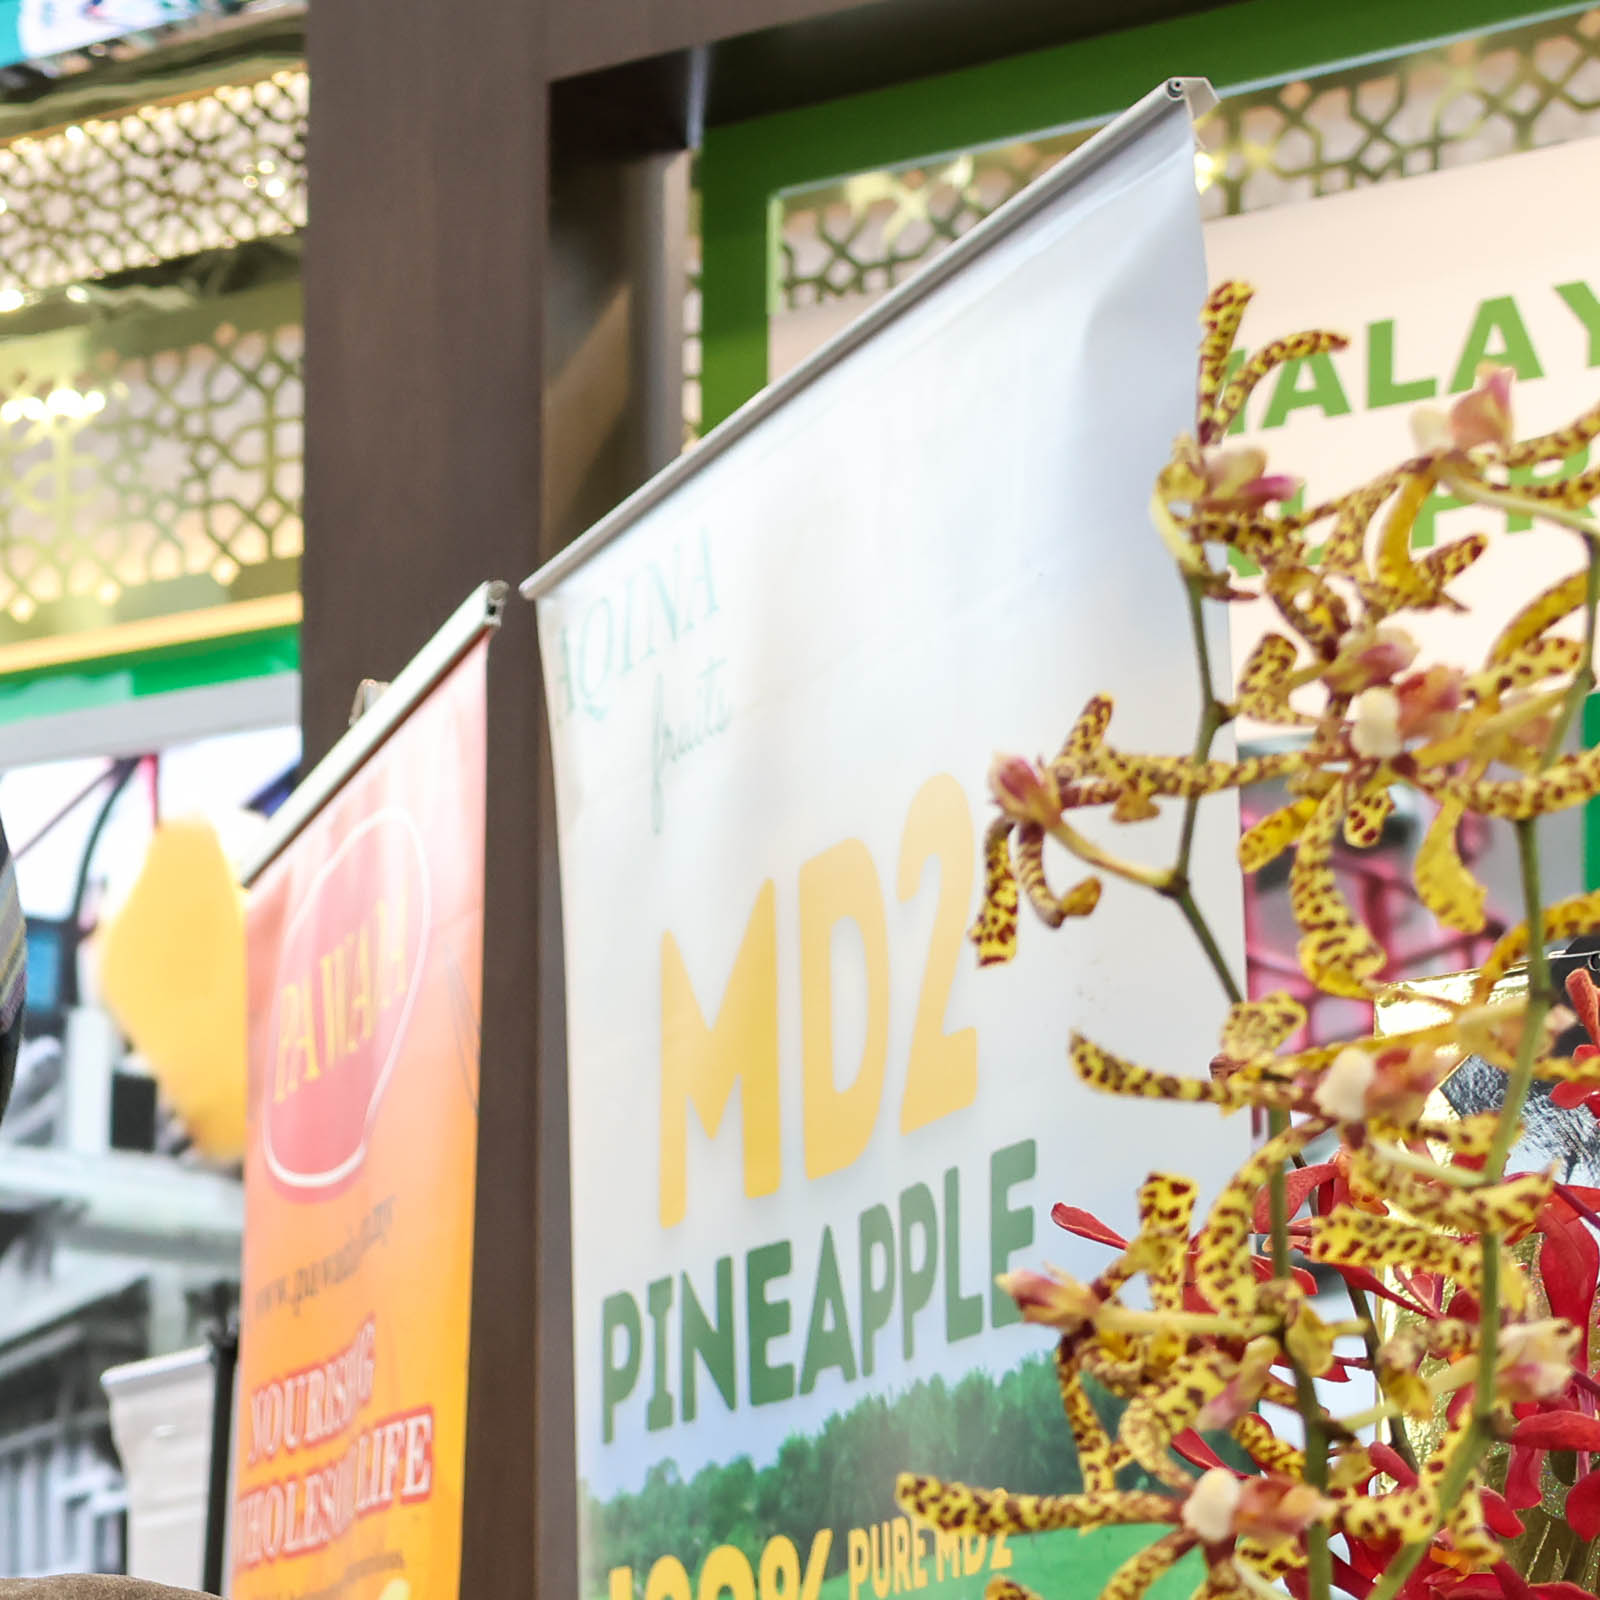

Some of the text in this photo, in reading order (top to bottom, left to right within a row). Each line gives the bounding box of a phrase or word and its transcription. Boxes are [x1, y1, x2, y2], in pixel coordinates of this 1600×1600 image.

[1224, 280, 1600, 437] ALAY
[658, 771, 980, 1229] MD2
[600, 1138, 1038, 1446] PINEAPPLE
[356, 1414, 433, 1511] LIFE
